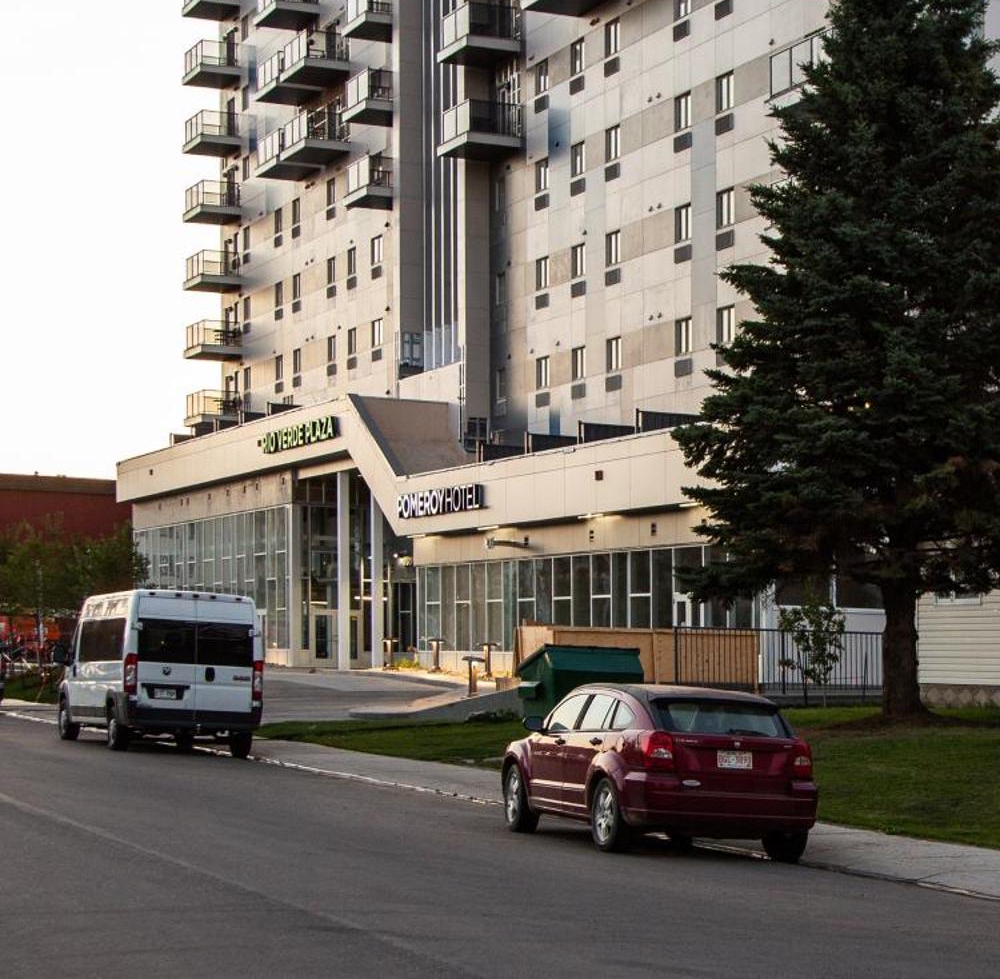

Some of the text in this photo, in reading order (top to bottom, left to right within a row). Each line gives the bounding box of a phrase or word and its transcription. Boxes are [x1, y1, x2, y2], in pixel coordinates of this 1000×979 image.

[276, 424, 304, 450] VERDE
[305, 415, 334, 443] PLAZA
[397, 482, 480, 519] POMEROY HOTEL
